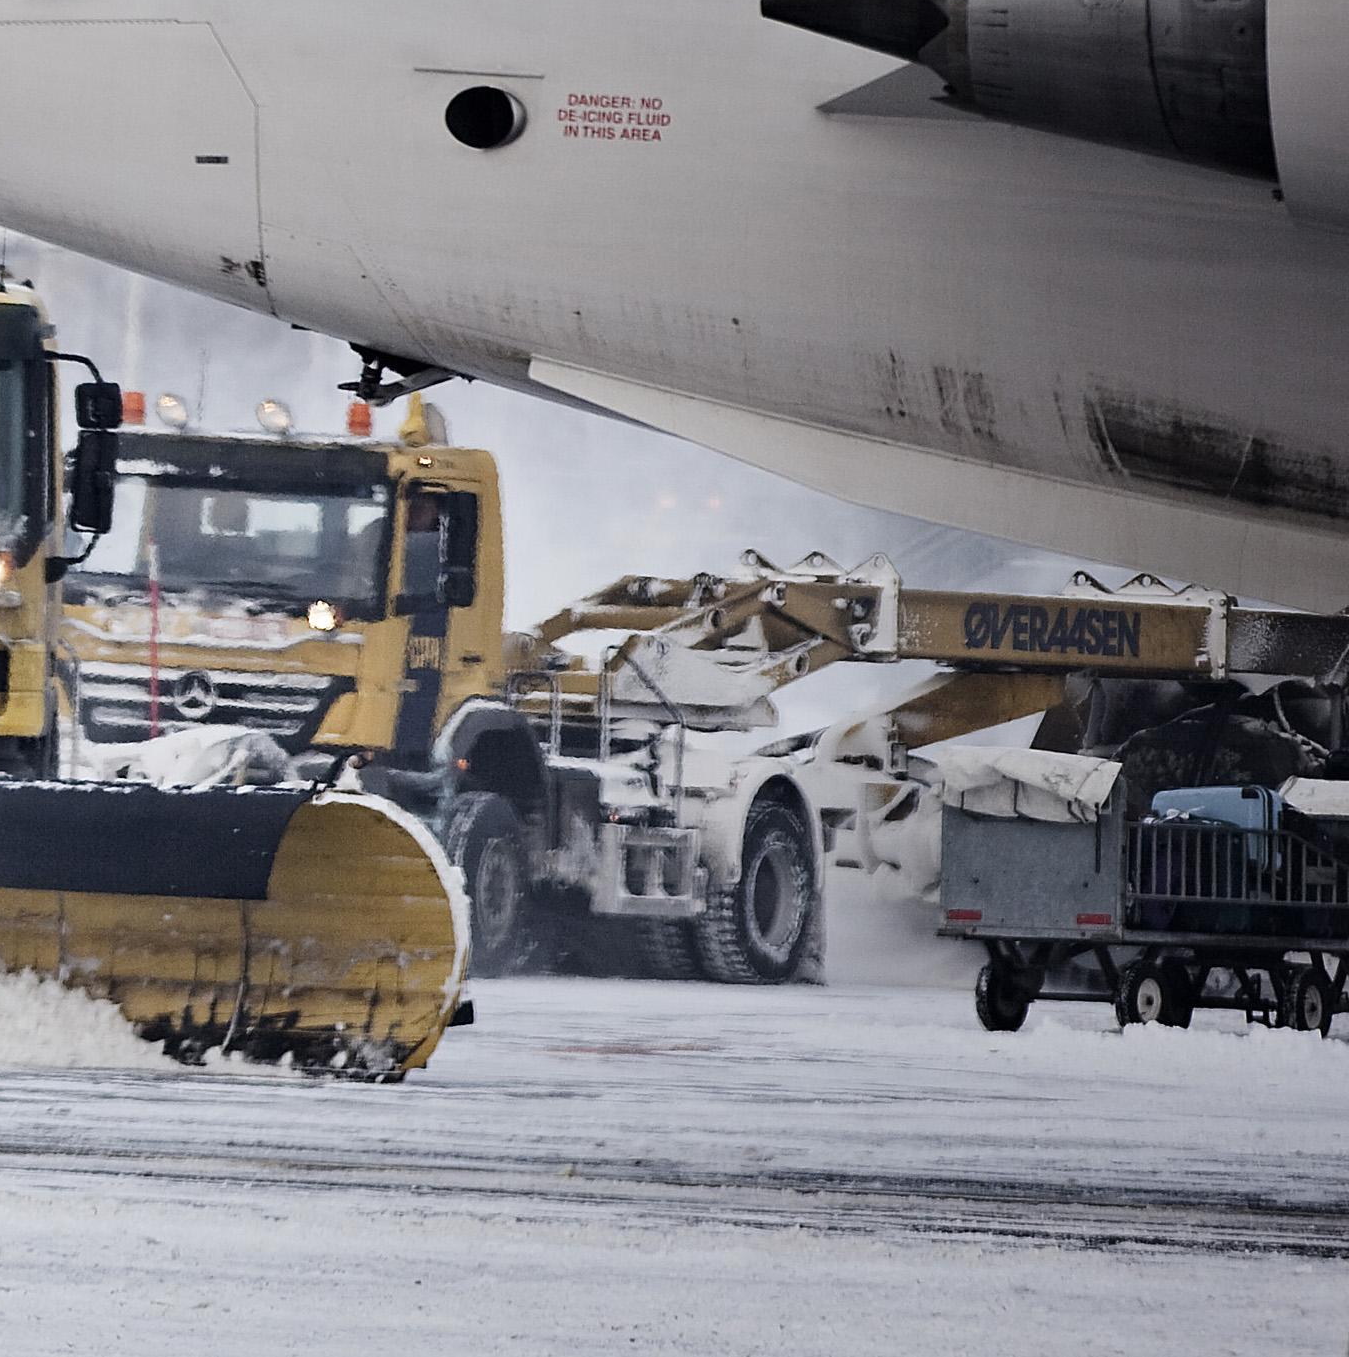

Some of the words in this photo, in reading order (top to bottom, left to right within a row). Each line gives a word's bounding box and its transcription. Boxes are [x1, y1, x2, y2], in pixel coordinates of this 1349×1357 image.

[640, 97, 664, 111] NO
[557, 108, 623, 125] DE-ICING
[627, 112, 671, 127] FLUID
[563, 125, 580, 138] IN
[582, 126, 616, 141] THIS
[619, 128, 662, 143] AREA
[963, 601, 1142, 658] ØVERAASEN
